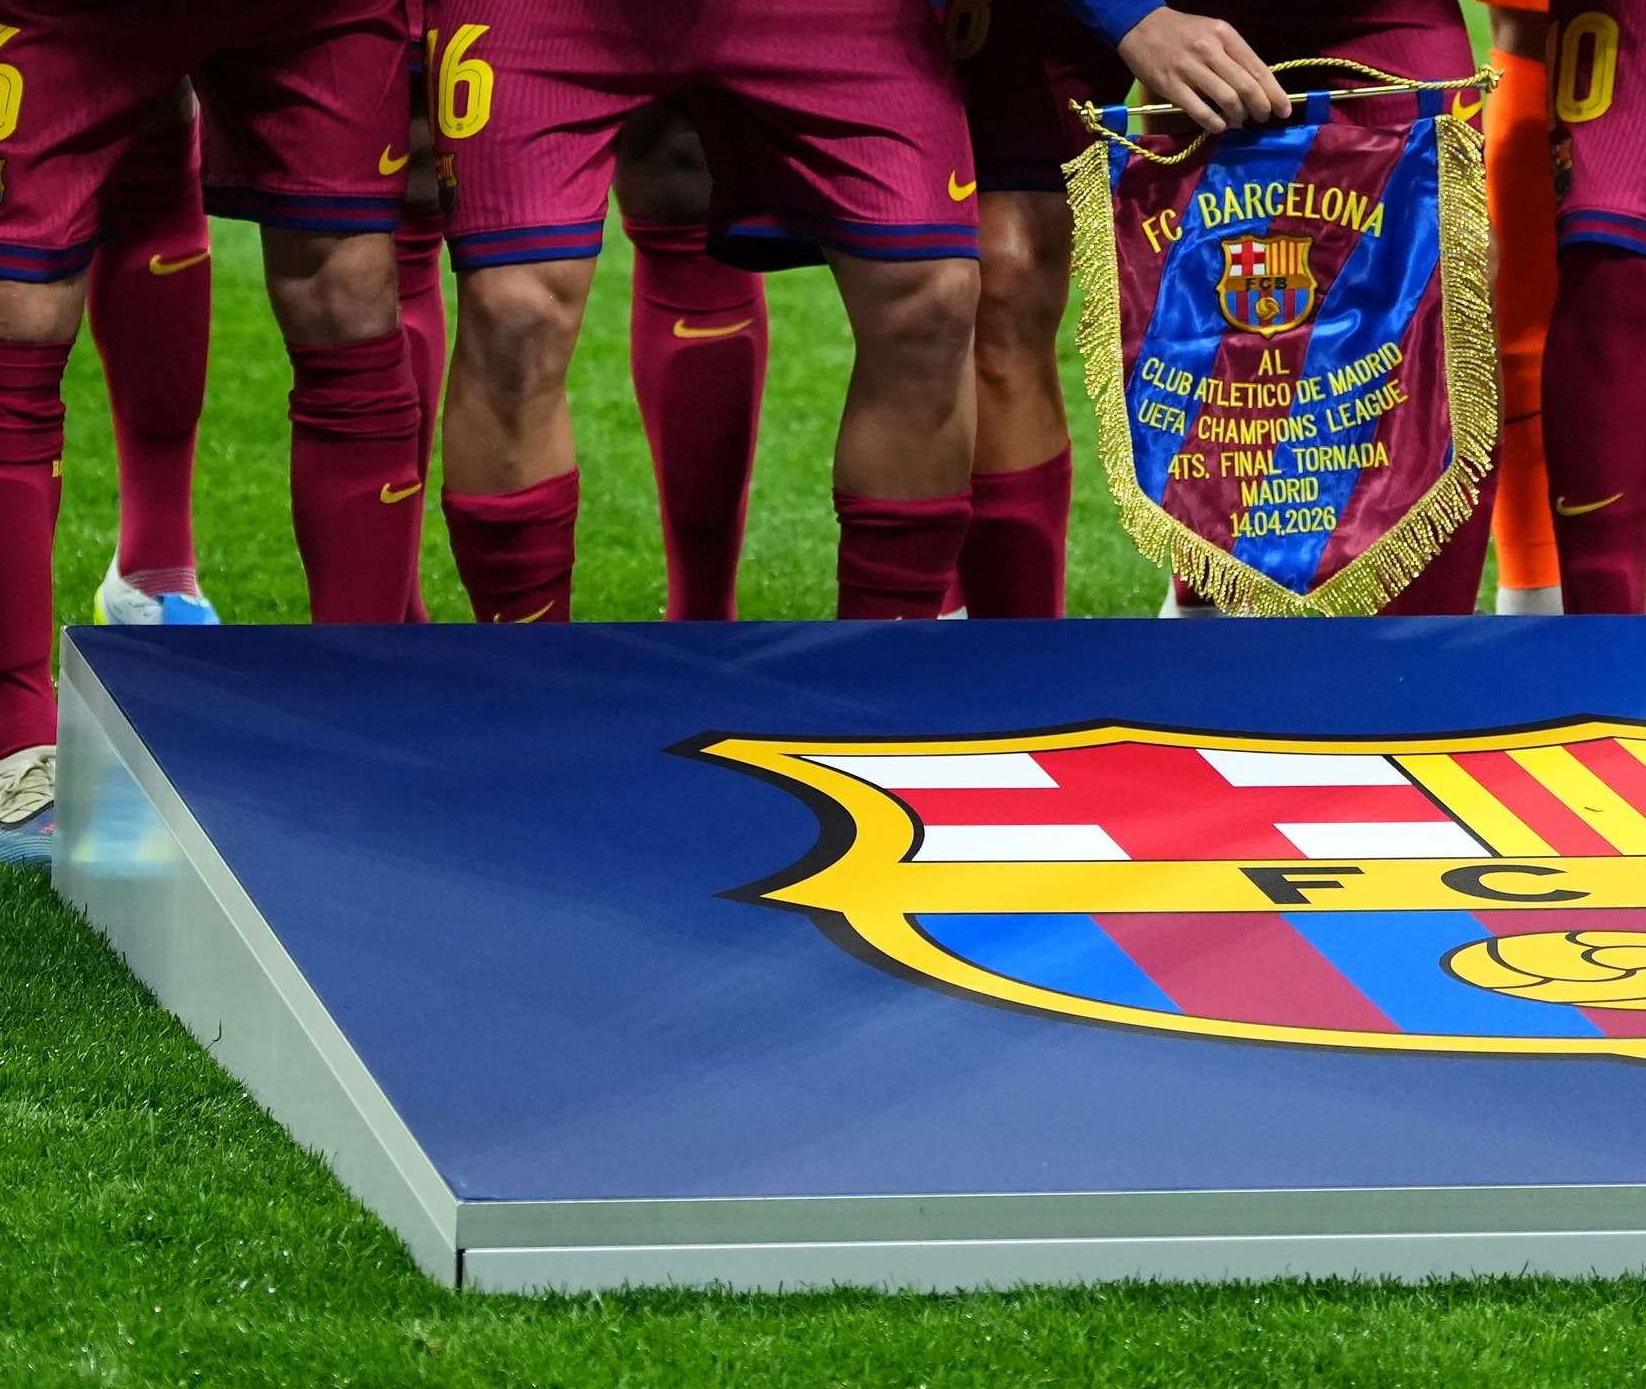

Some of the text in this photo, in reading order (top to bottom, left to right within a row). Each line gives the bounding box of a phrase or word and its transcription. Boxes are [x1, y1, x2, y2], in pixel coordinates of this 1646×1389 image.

[1142, 182, 1385, 253] FC BARCELONA
[1243, 277, 1288, 291] FCB
[1141, 342, 1404, 408] CLUB ATLETICO DE MADRID
[1258, 349, 1290, 376] AL
[1137, 380, 1409, 445] UEFA CHAMPIONS LEAGUE
[1220, 447, 1282, 477] FINAL
[1293, 441, 1390, 471] TORNADA
[1241, 476, 1319, 506] MADRID
[1230, 506, 1337, 538] 14.04.2026
